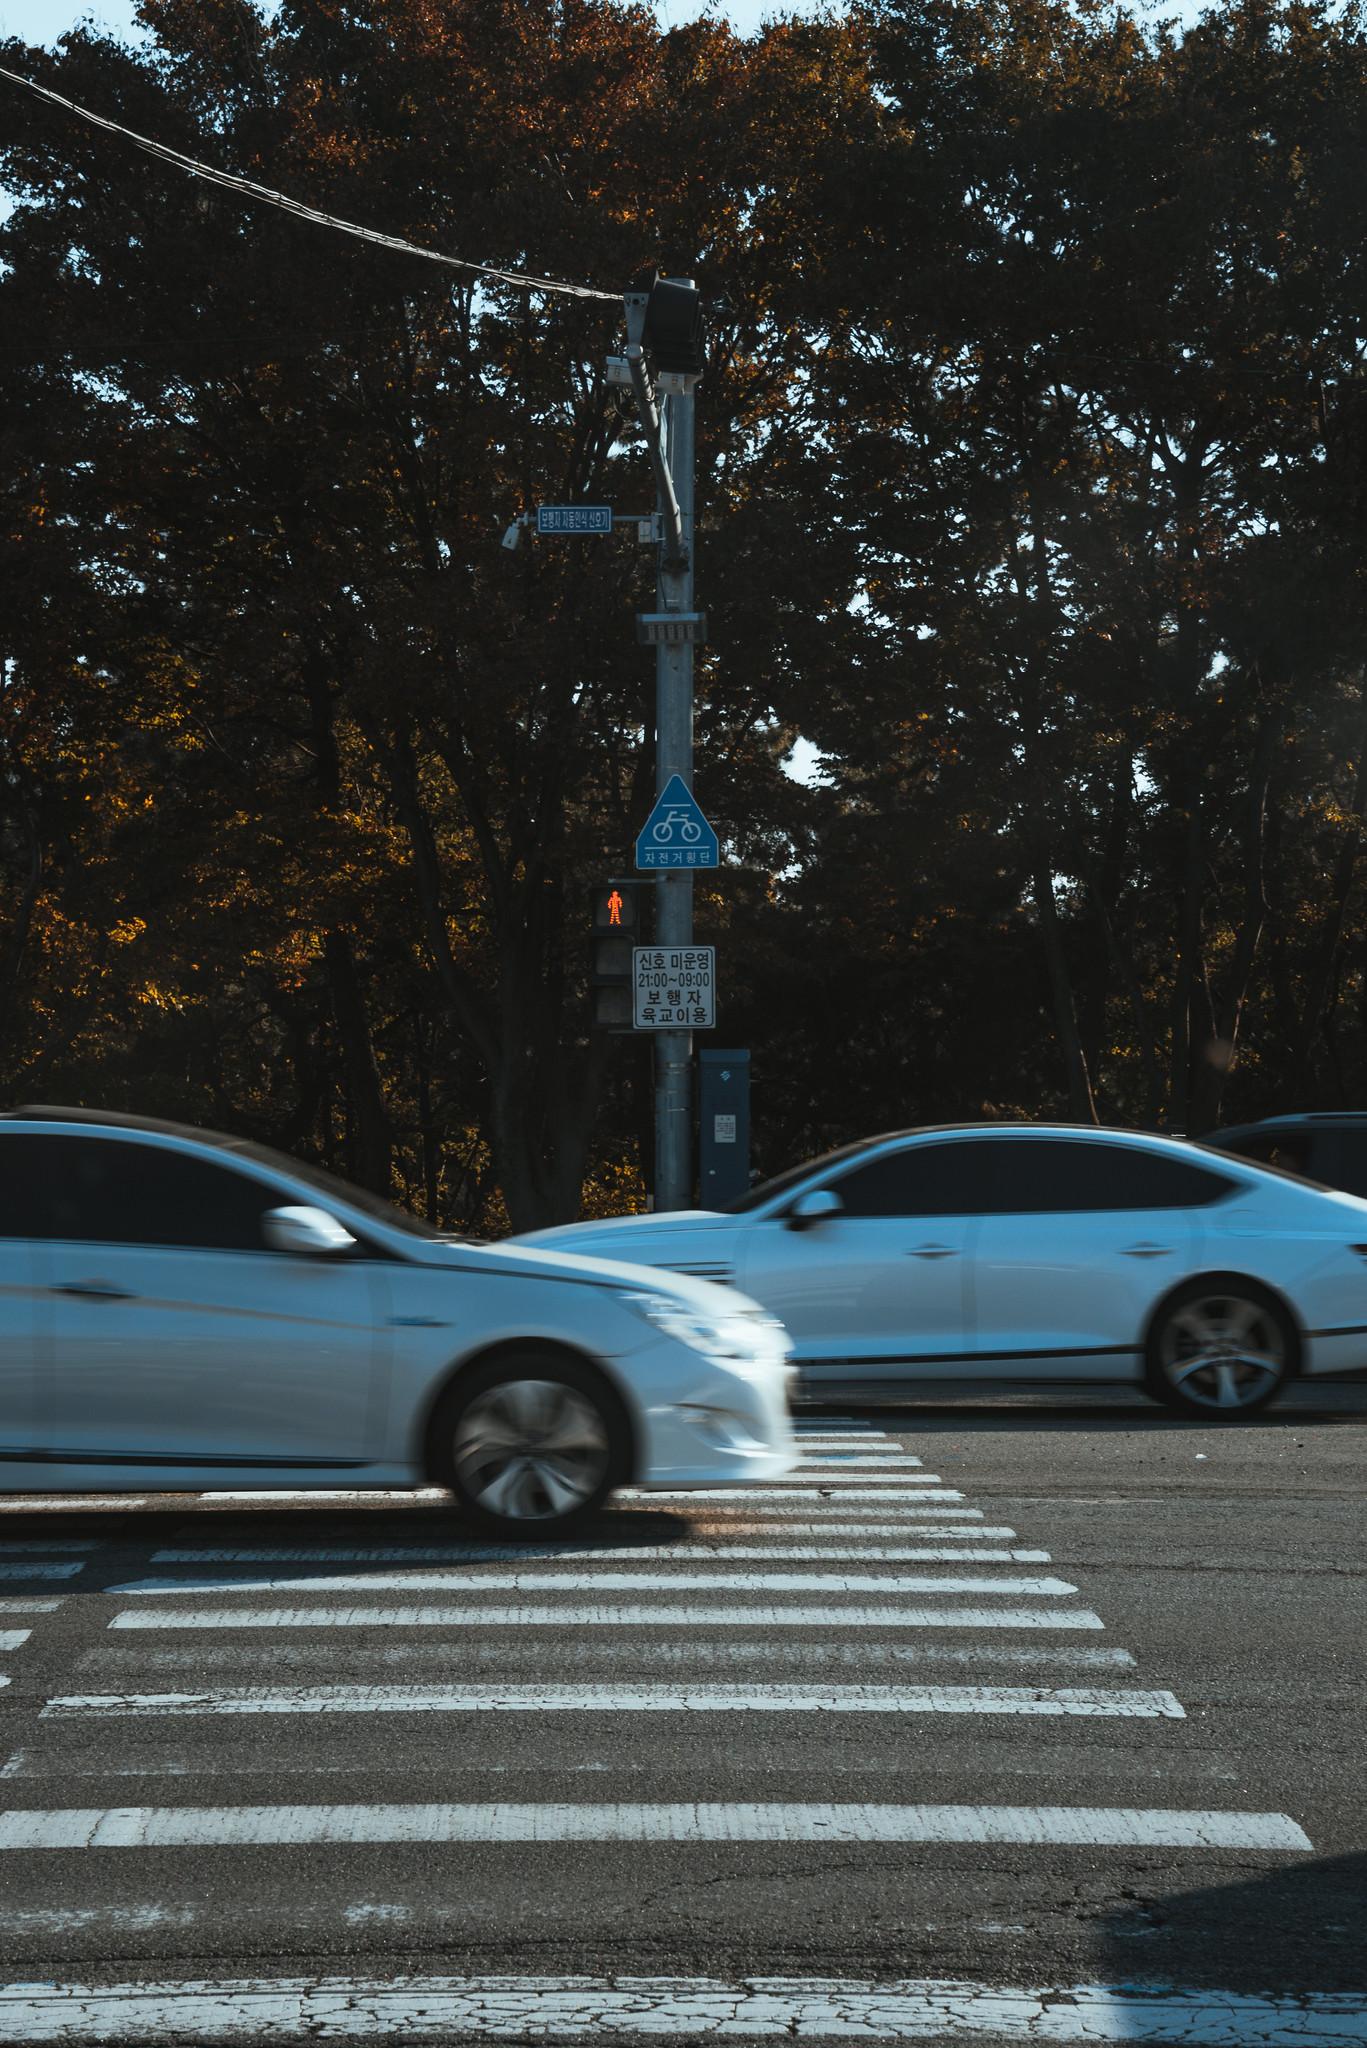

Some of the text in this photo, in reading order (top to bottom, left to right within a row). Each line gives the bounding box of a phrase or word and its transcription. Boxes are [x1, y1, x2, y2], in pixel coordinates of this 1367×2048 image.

[542, 511, 608, 529] 보행자 자동인식 신호기
[644, 851, 710, 864] 자전거횡단
[639, 952, 709, 971] 신호 미운영
[638, 972, 710, 988] 21:00~09:00
